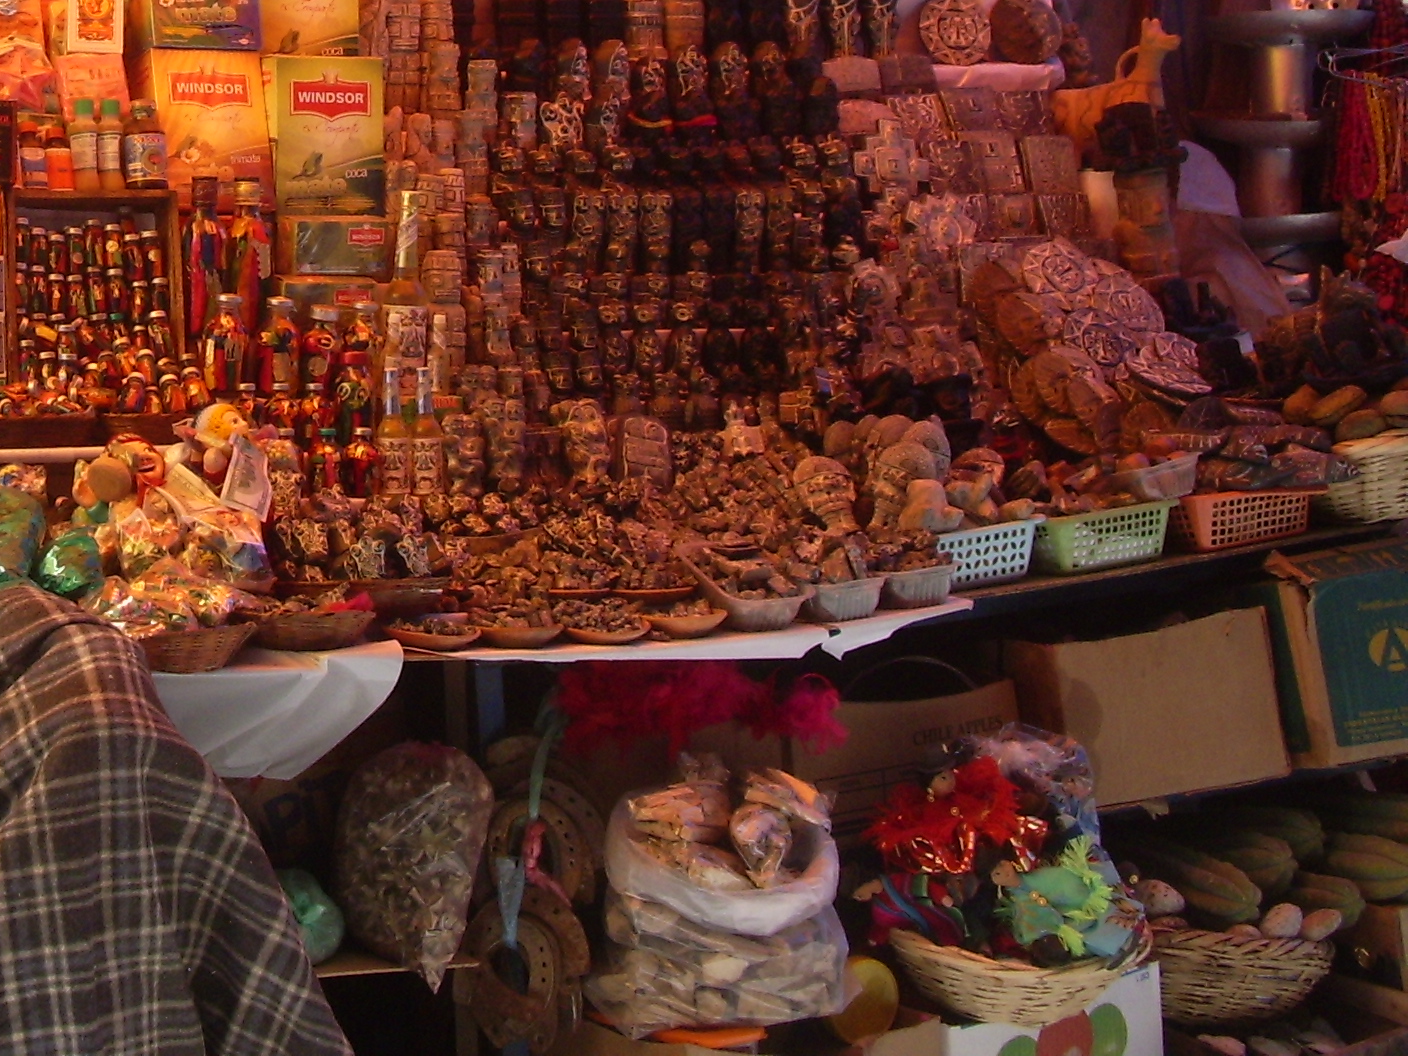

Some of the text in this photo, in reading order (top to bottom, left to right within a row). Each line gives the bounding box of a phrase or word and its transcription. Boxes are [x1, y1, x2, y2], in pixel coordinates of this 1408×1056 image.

[175, 82, 244, 95] WINDSOR
[297, 91, 364, 104] WINDSOR
[344, 167, 368, 179] coca
[958, 716, 1004, 736] APPLES
